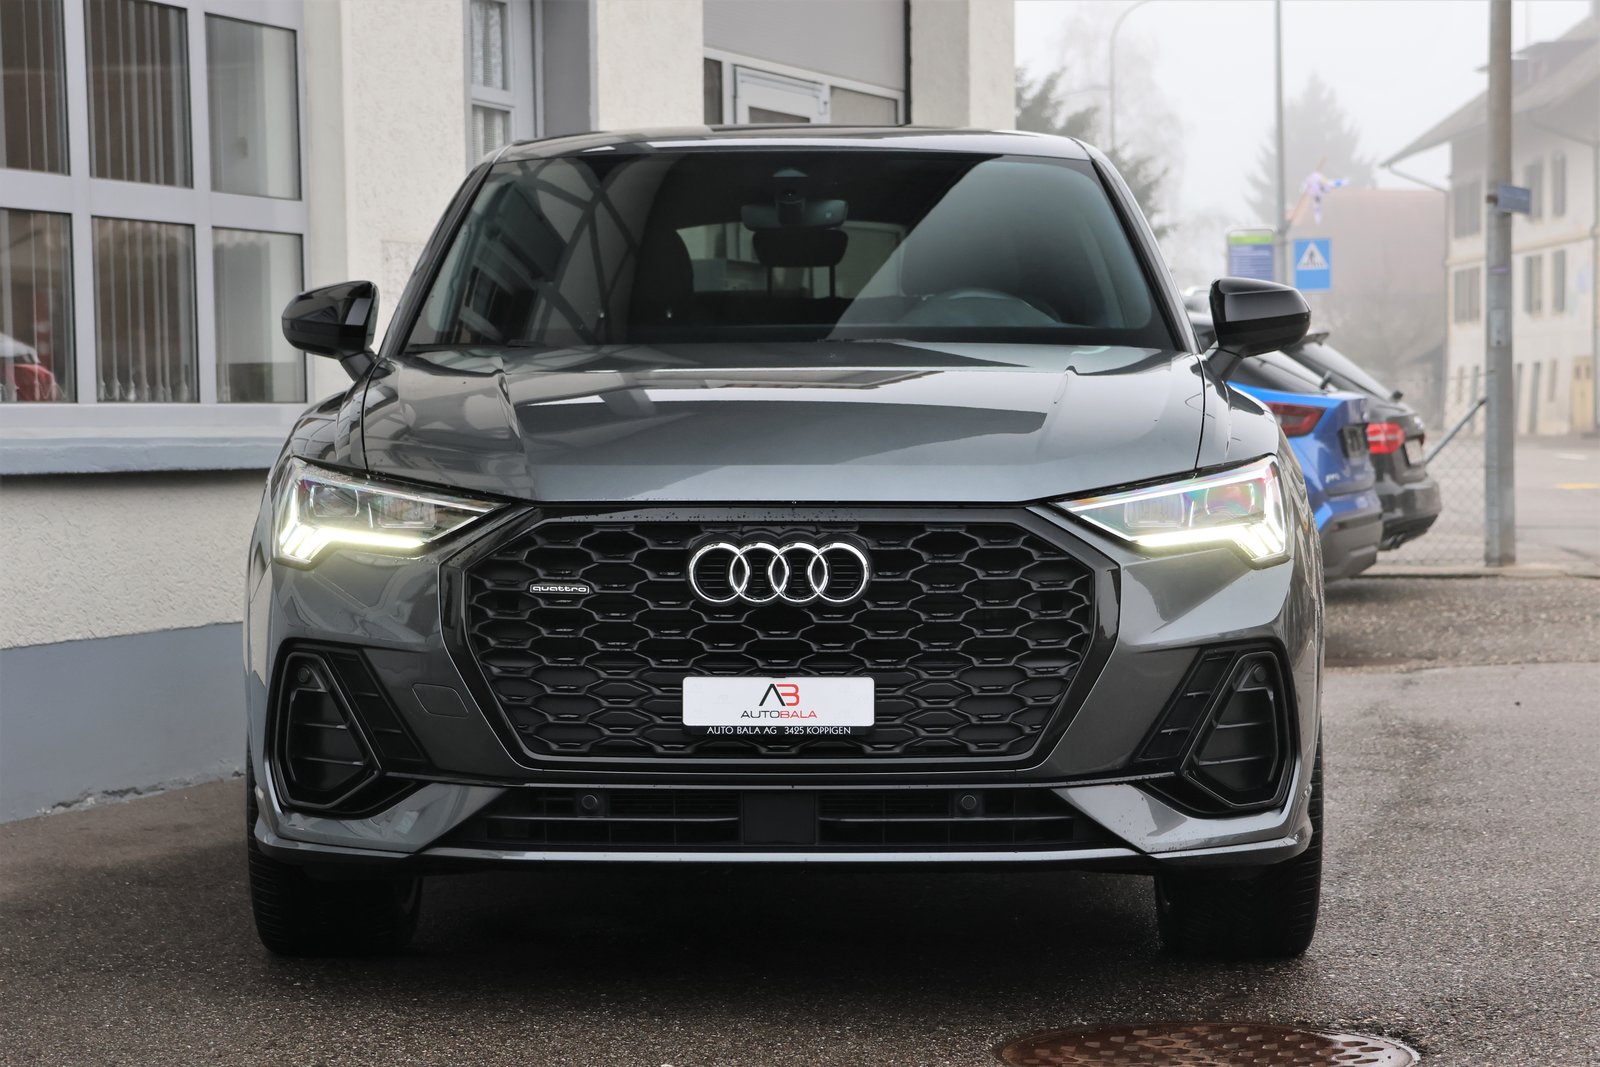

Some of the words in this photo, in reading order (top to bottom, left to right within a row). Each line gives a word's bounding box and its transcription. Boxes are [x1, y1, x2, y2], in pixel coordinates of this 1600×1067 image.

[759, 683, 800, 706] AB
[741, 710, 818, 719] AUTOBALA
[707, 726, 734, 735] AUTO
[737, 726, 761, 735] BALA
[763, 726, 777, 735] AG
[784, 726, 804, 735] 3425
[806, 726, 851, 735] KOPPIGEN
